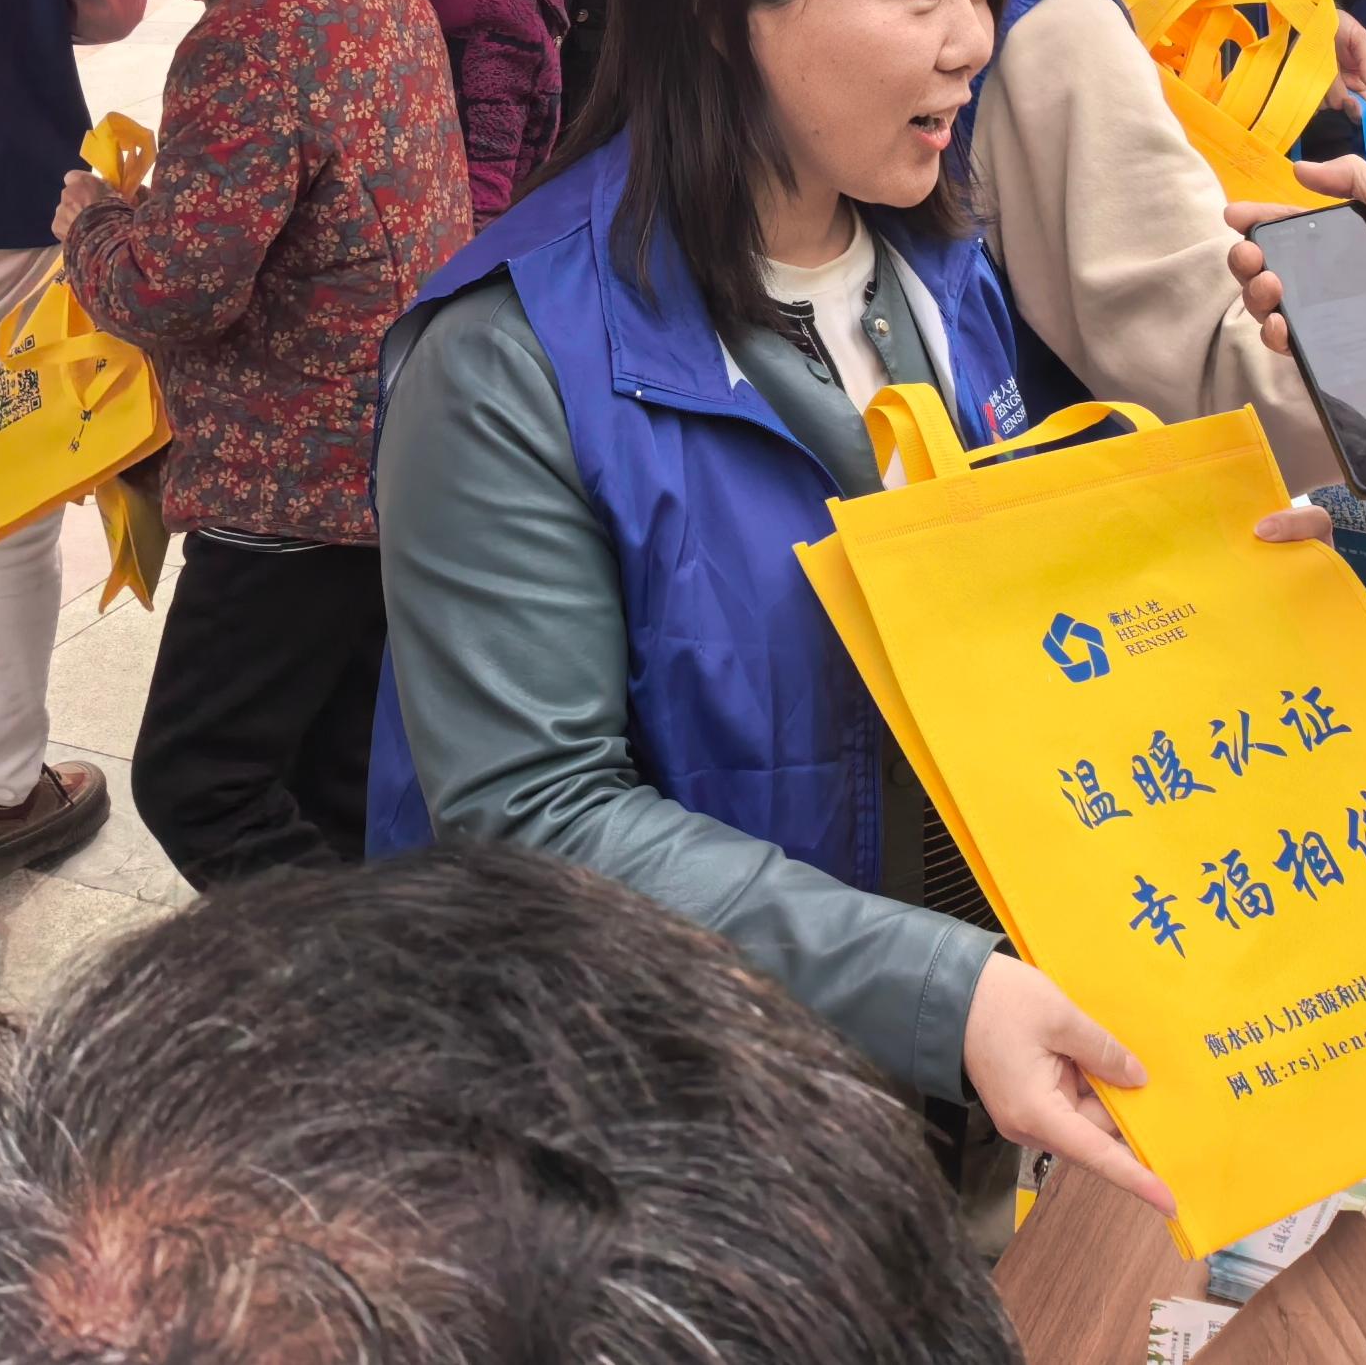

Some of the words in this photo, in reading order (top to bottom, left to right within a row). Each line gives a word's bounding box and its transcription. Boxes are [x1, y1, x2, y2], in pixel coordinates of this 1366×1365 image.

[1108, 599, 1163, 627] 衡水人社
[1116, 603, 1197, 641] HENGSHUI
[1125, 626, 1188, 657] RENSHE
[1057, 686, 1352, 830] 温暖认证
